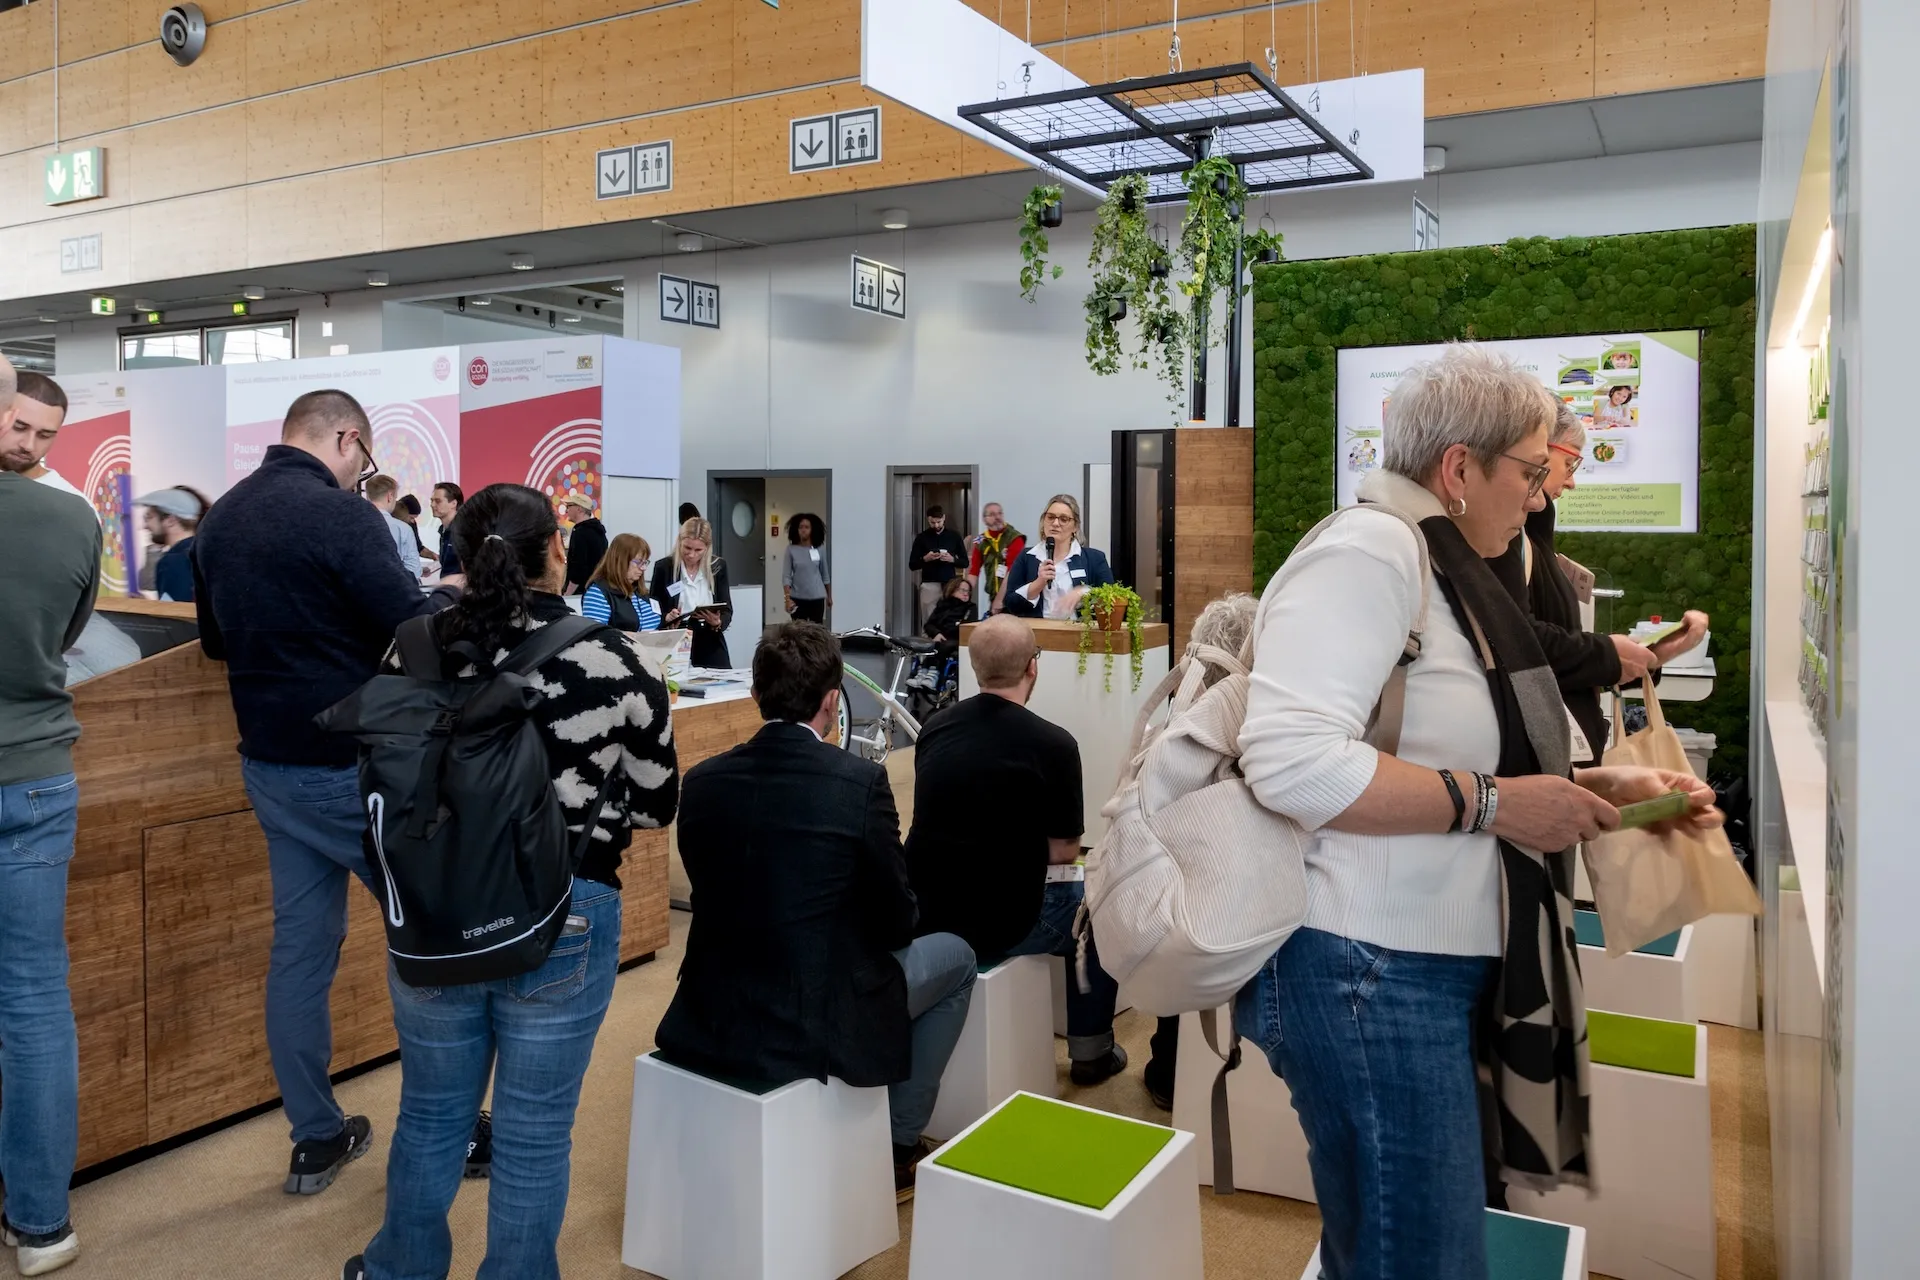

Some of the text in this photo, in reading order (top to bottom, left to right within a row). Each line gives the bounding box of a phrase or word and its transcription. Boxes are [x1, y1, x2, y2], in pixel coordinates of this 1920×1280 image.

[470, 363, 488, 374] con
[1370, 370, 1404, 379] AUSWAH
[1602, 509, 1665, 517] Online-Fortbildungen
[1603, 517, 1635, 525] Lernportal
[462, 916, 515, 940] travelite
